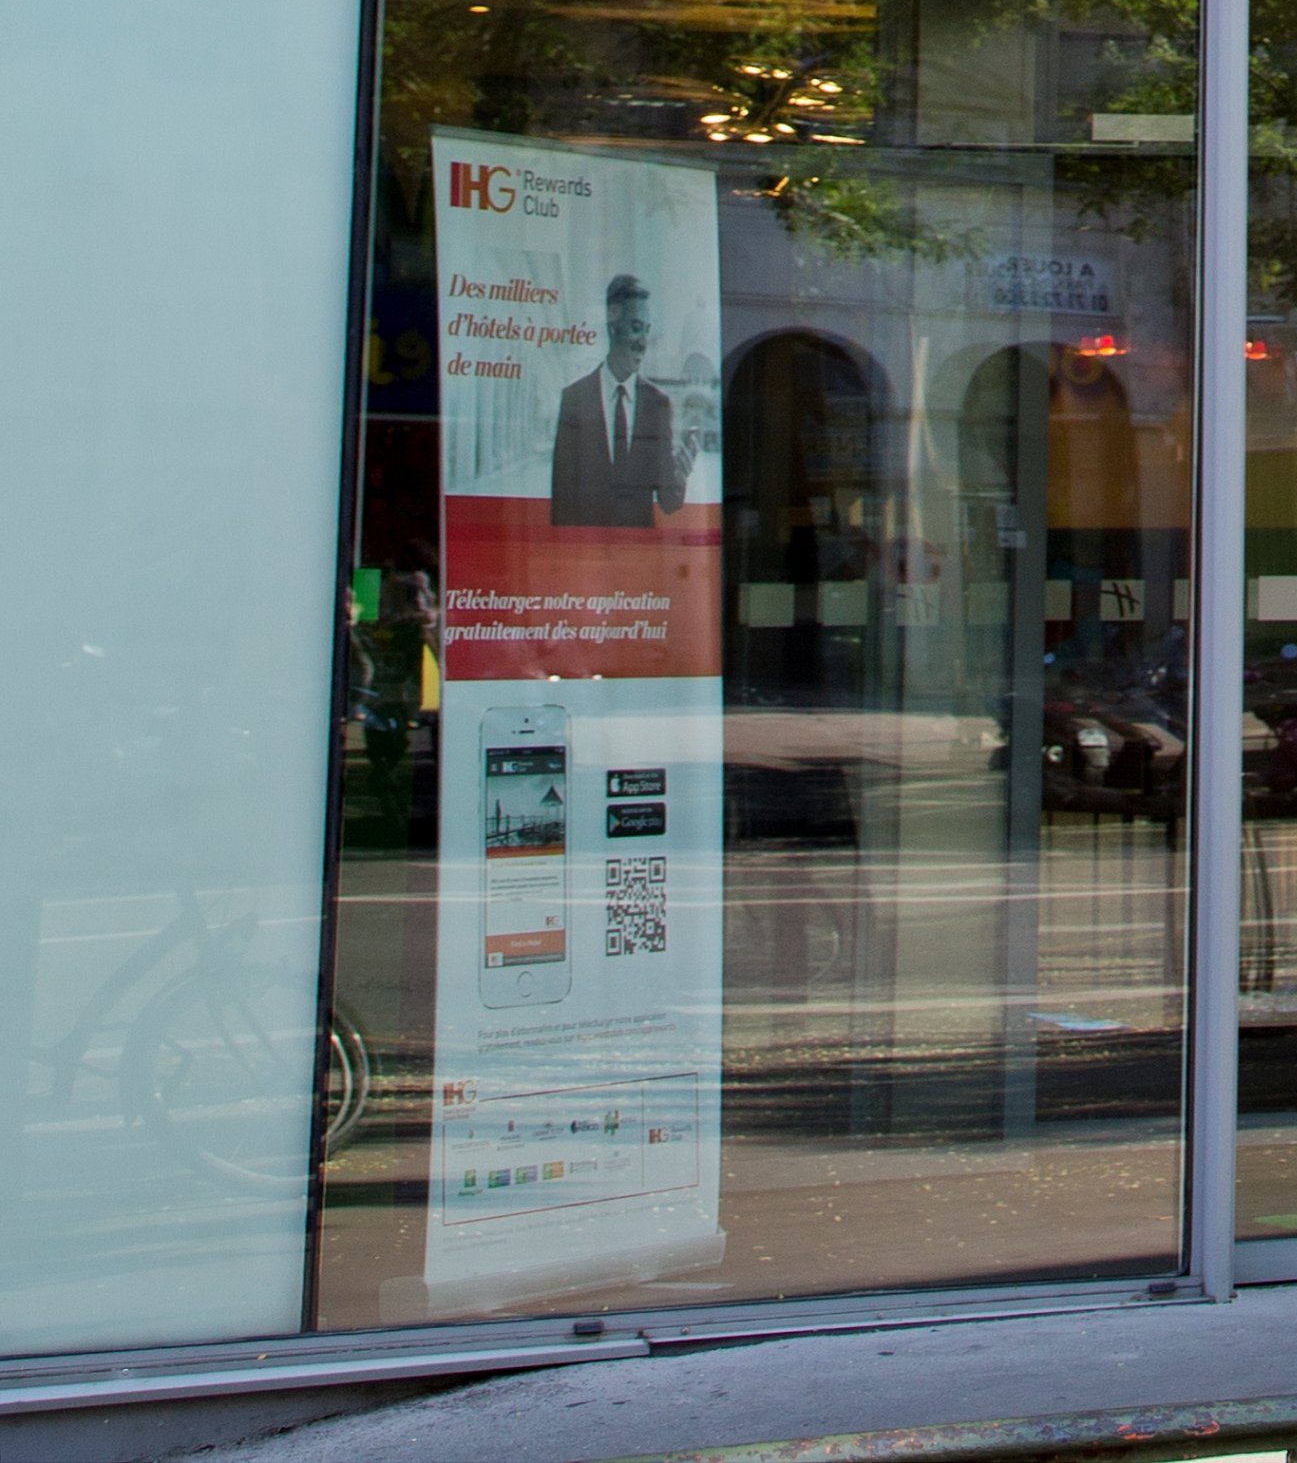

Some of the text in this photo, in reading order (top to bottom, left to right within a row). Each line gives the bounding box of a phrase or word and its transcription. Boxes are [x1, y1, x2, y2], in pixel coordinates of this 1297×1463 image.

[450, 161, 592, 214] IHG Rewards
[523, 195, 560, 218] Club
[449, 273, 558, 304] Des milliers
[524, 316, 535, 342] à
[537, 321, 597, 348] portée
[448, 352, 522, 380] de main
[446, 588, 671, 614] Téléchargez notre application
[444, 620, 550, 645] gratuitement
[552, 619, 577, 640] dès
[443, 1080, 477, 1107] IHG
